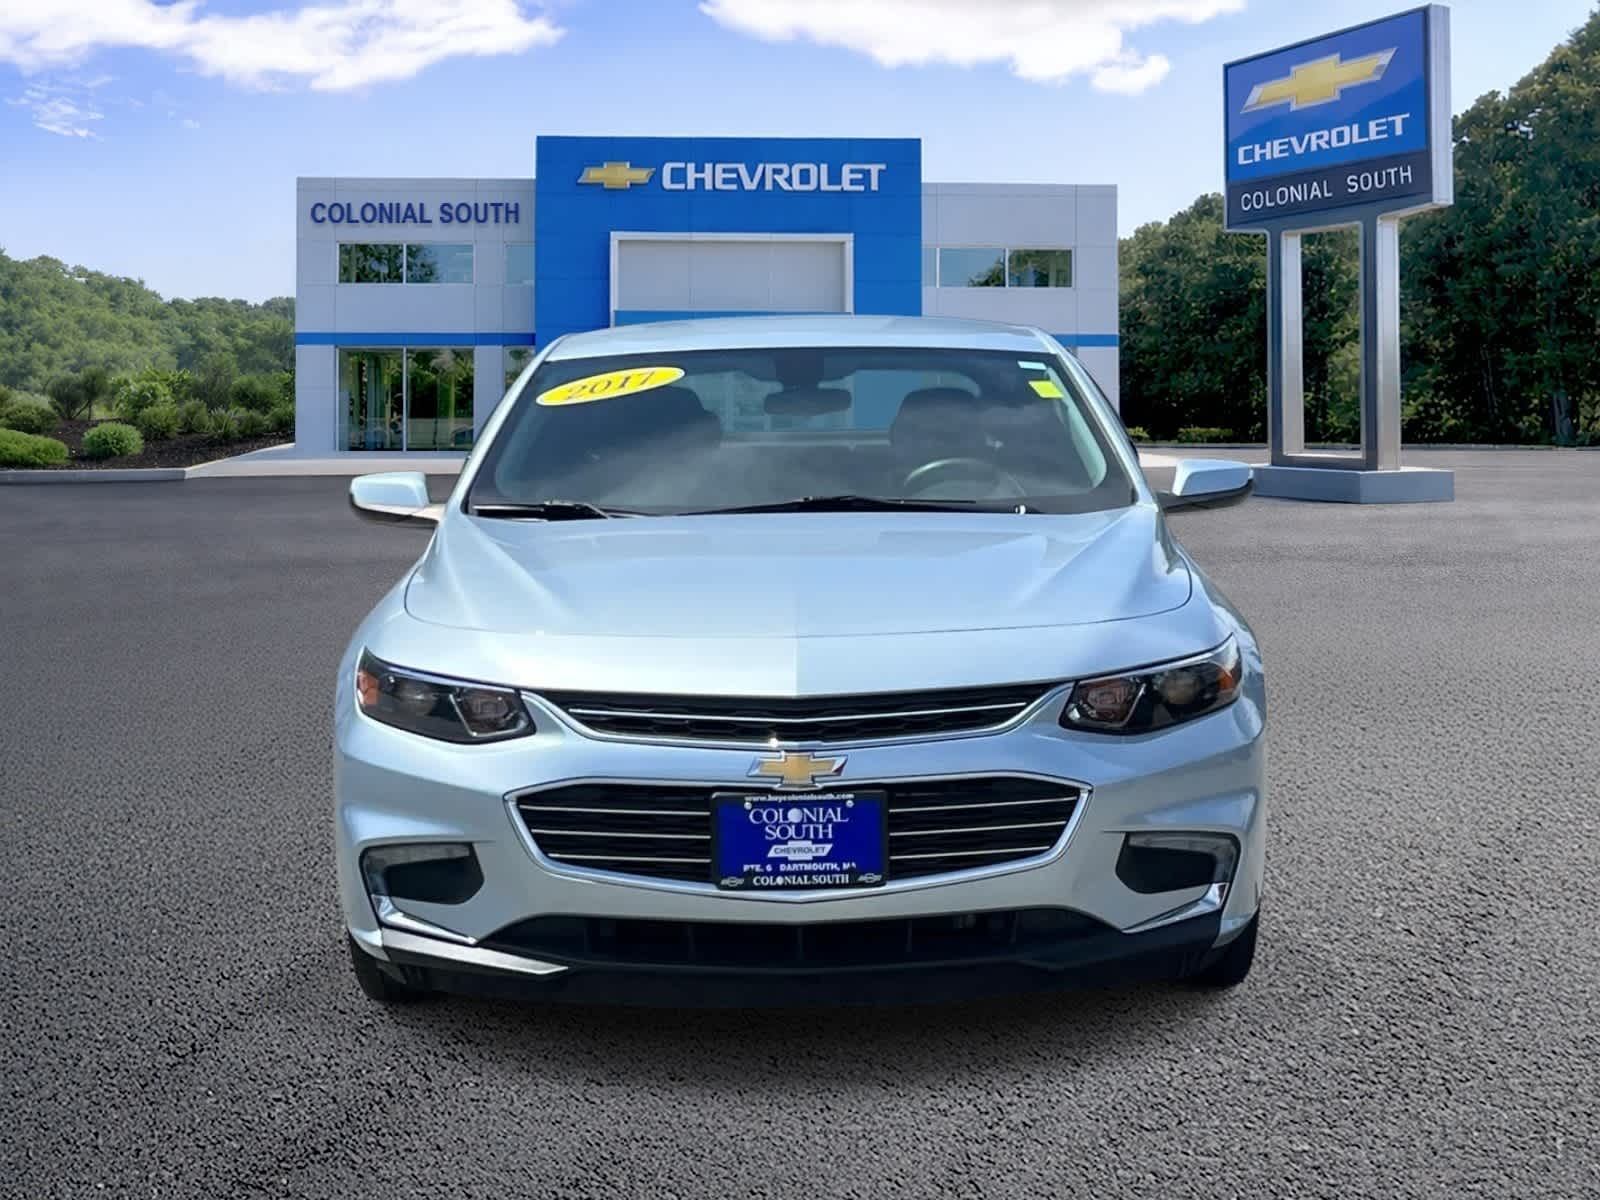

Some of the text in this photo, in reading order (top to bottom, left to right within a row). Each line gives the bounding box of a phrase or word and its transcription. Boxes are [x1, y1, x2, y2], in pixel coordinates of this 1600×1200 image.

[1237, 112, 1411, 166] CHEVROLET
[661, 161, 887, 193] CHEVROLET
[1240, 164, 1413, 212] COLONIAL SOUTH
[310, 201, 521, 225] COLONIAL SOUTH
[565, 371, 656, 401] 2017
[749, 807, 849, 824] COLONIAL
[765, 823, 834, 840] SOUTH
[773, 846, 827, 855] CHEVROLET
